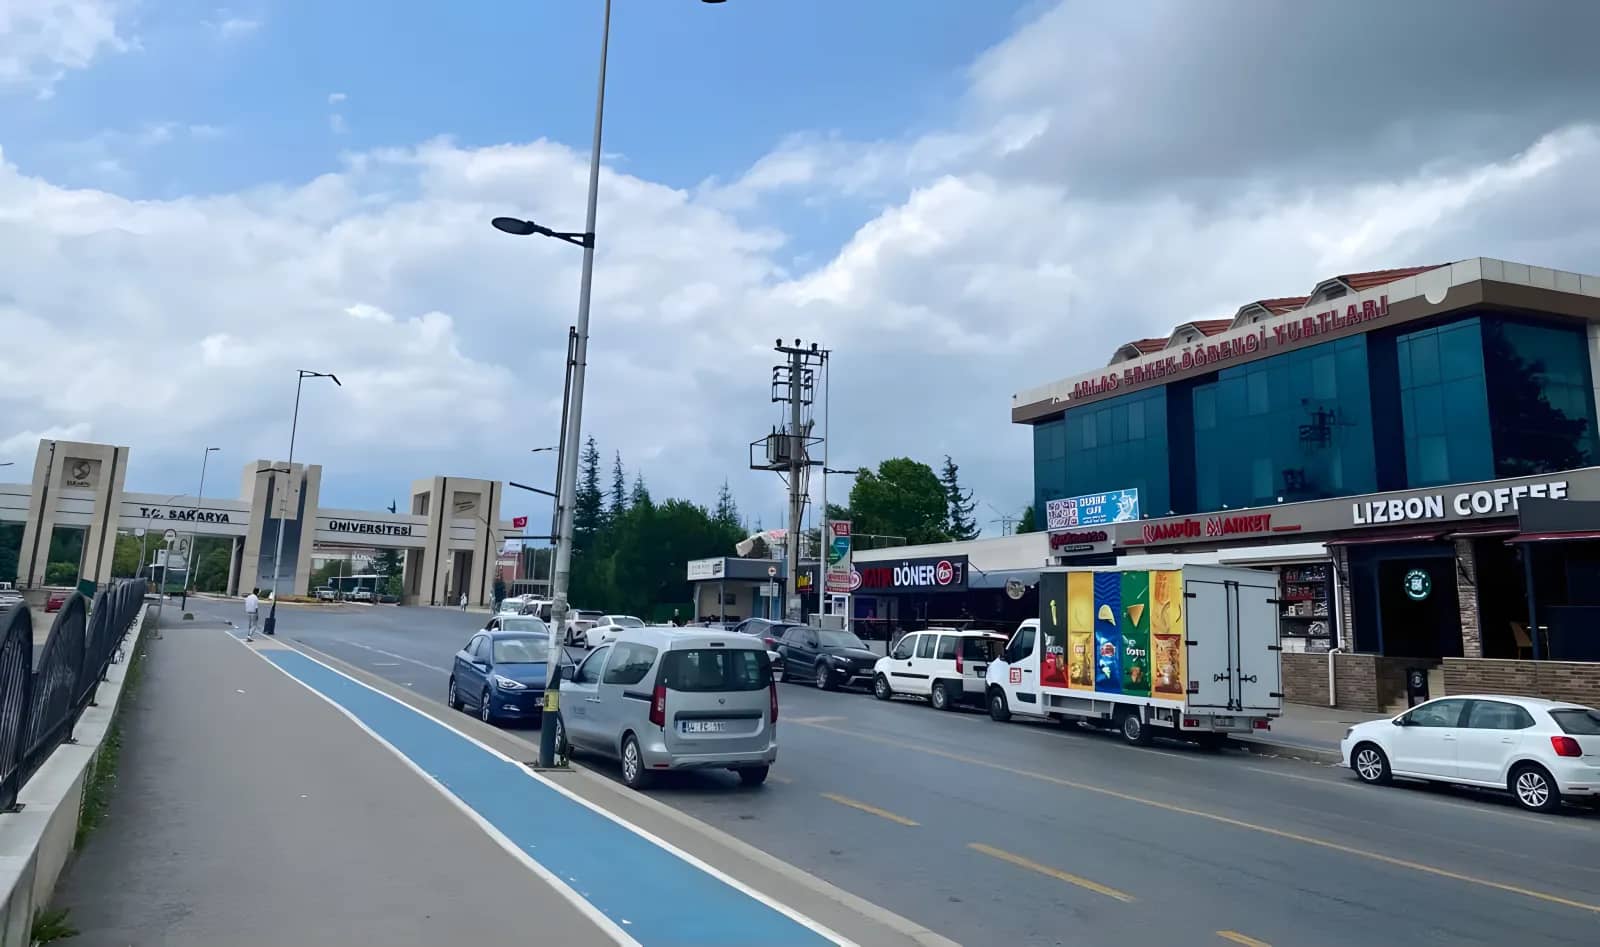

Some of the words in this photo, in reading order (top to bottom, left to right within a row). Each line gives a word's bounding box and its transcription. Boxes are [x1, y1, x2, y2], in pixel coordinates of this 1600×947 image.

[1273, 295, 1389, 345] YURTLARI
[168, 509, 230, 523] SAKARYA
[1352, 495, 1445, 525] LIZBON
[329, 520, 412, 536] ÜNİVERSİTESİ
[1205, 513, 1271, 537] MARKET
[893, 562, 936, 586] DÖNER
